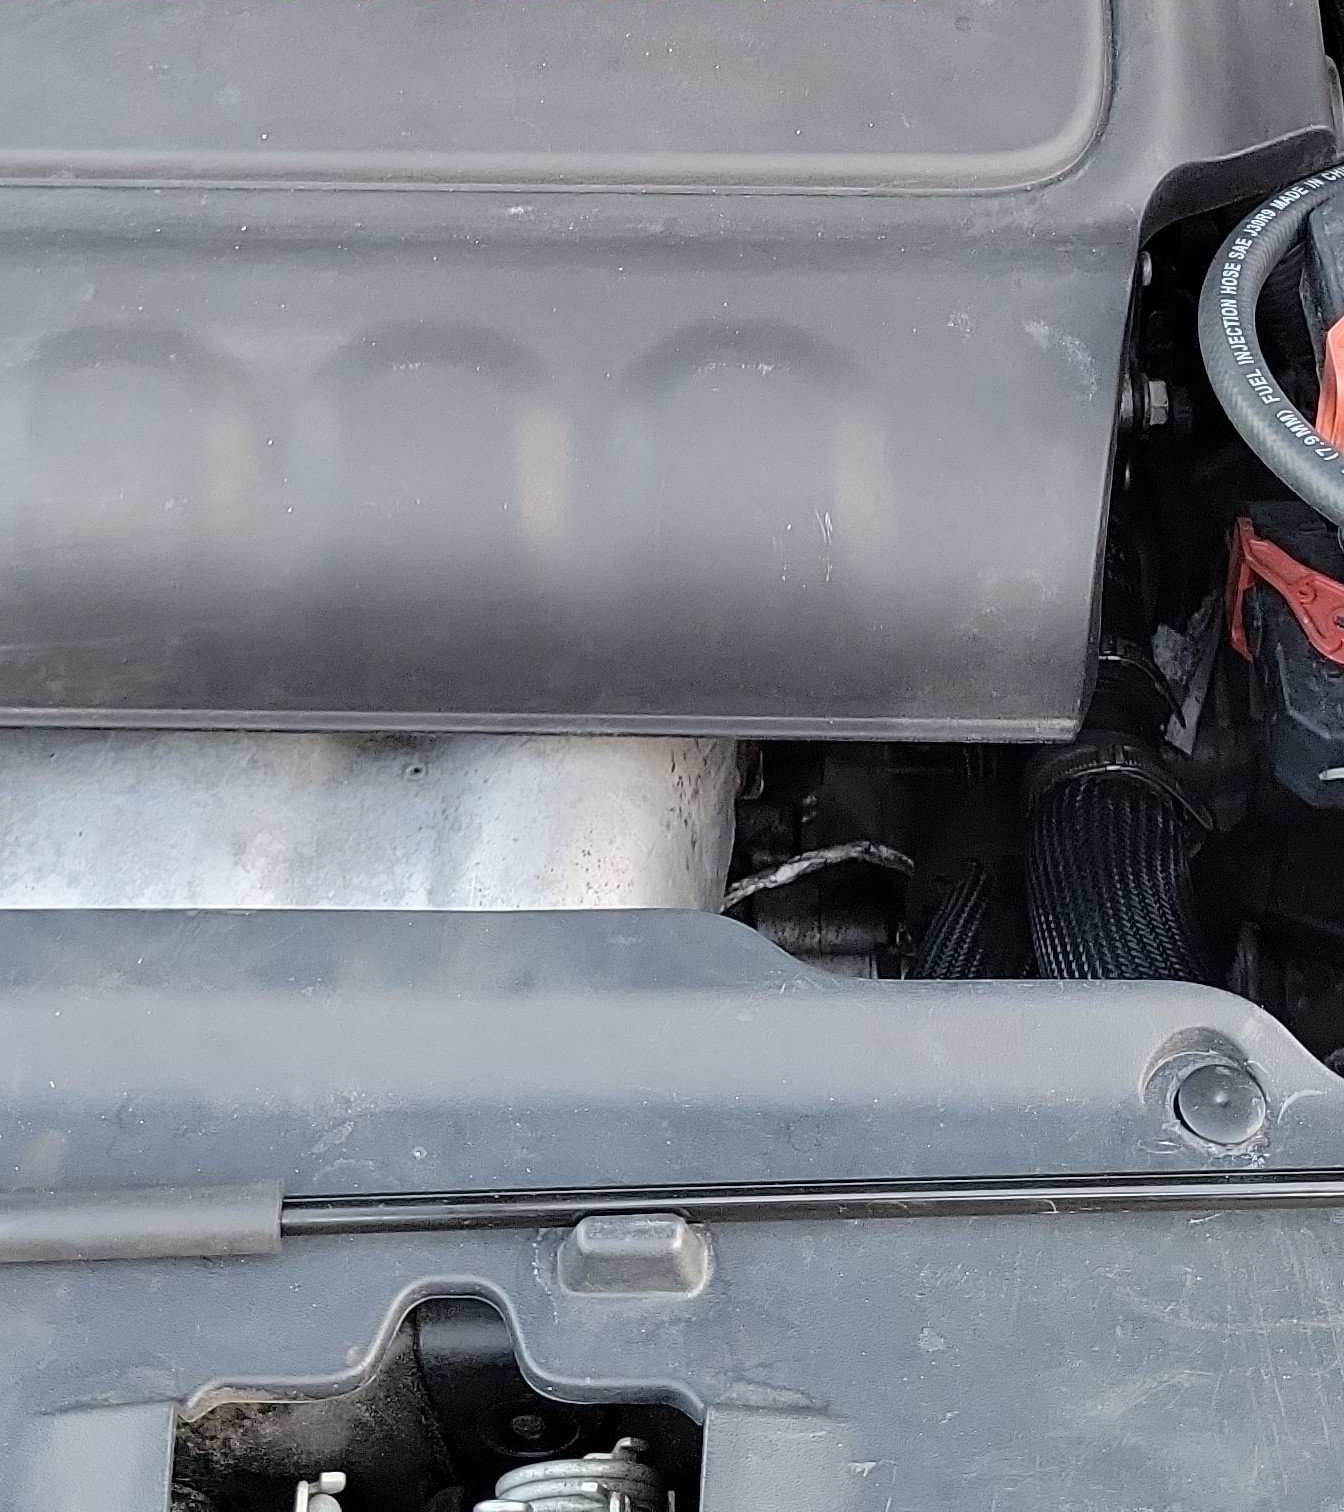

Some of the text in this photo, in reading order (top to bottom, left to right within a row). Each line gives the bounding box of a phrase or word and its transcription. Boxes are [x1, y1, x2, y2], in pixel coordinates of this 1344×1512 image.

[1270, 184, 1309, 211] MADE
[1305, 176, 1325, 189] IN
[1243, 209, 1277, 237] J30R9
[1228, 237, 1253, 260] SAE
[1220, 262, 1242, 295] HOSE
[1220, 297, 1255, 366] INJECTION
[1246, 368, 1281, 405] FUEL
[1275, 409, 1339, 462] (7.9MM)
